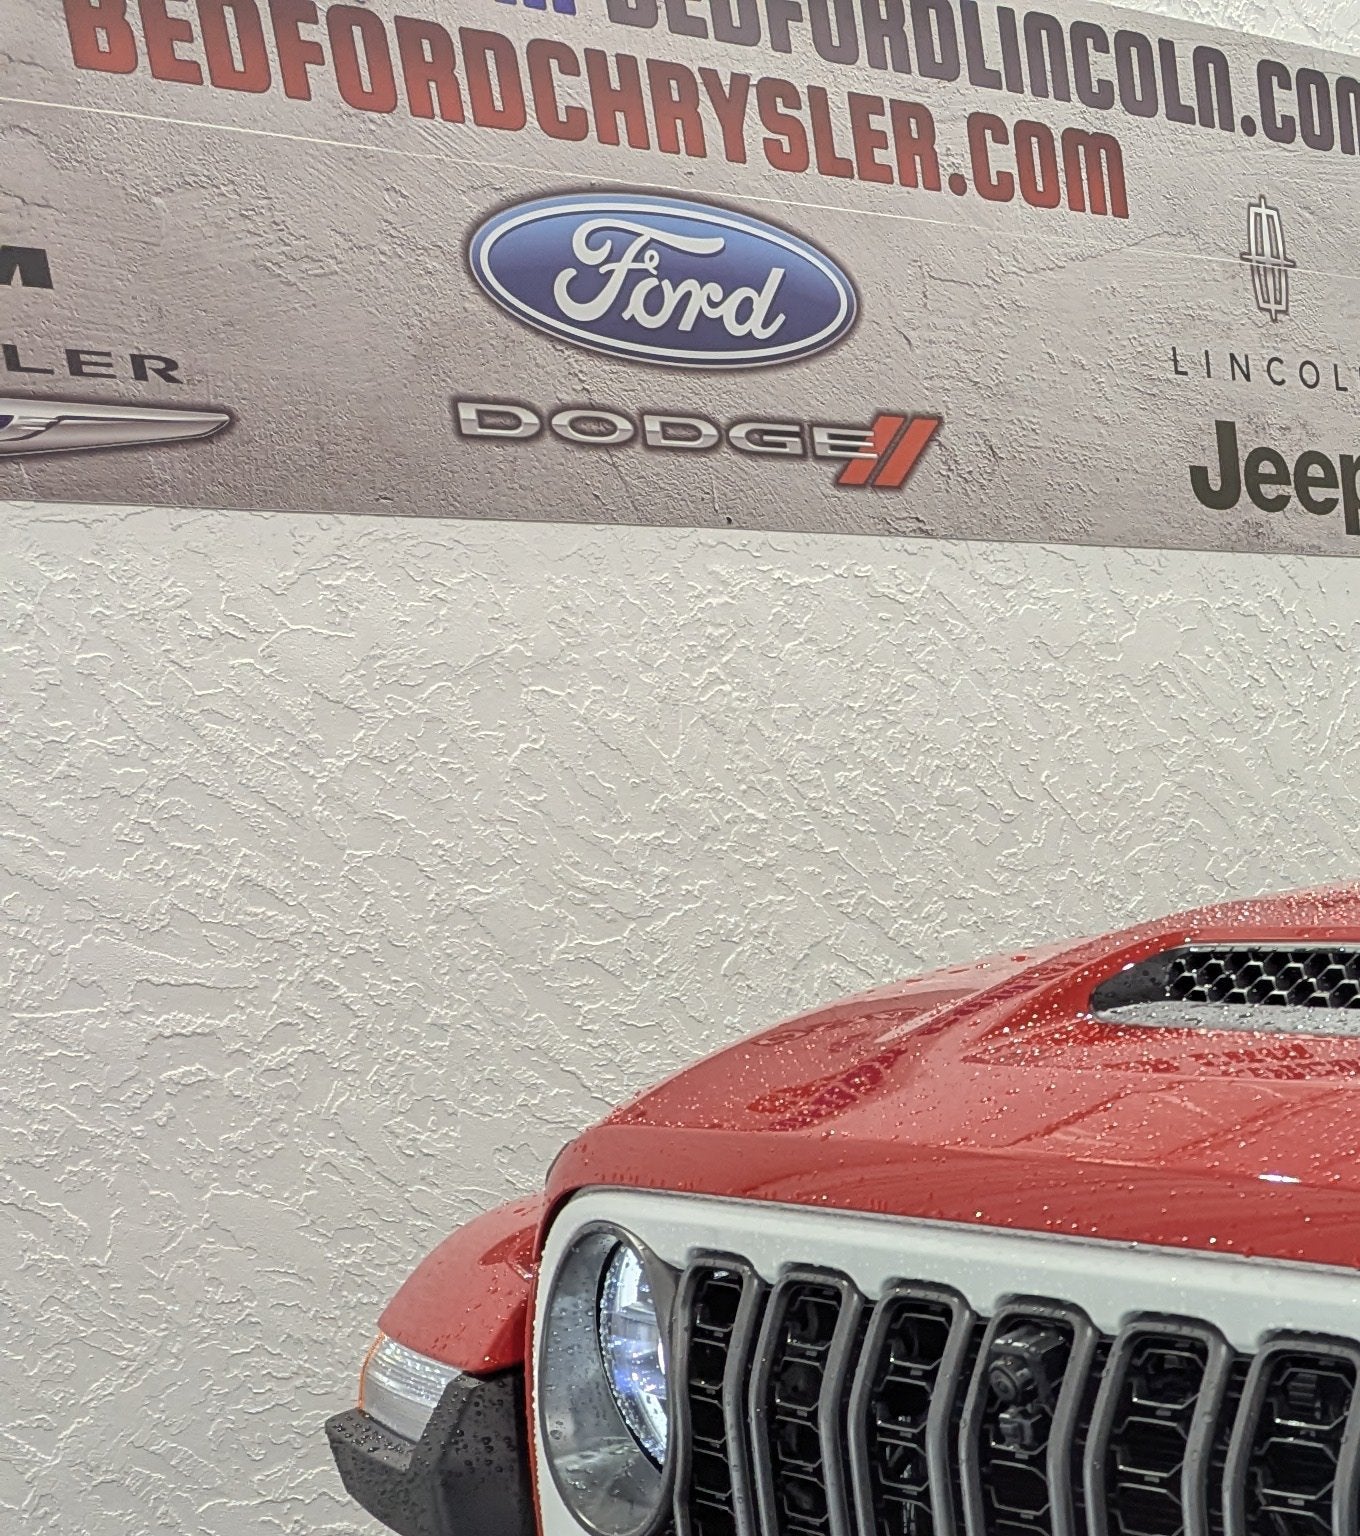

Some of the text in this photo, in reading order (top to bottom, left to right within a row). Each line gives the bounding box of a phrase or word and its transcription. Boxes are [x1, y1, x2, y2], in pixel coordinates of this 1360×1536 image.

[65, 0, 1130, 219] BEDFORDCHRYSLER.COM
[553, 217, 787, 341] Ford
[456, 401, 878, 461] DODGE
